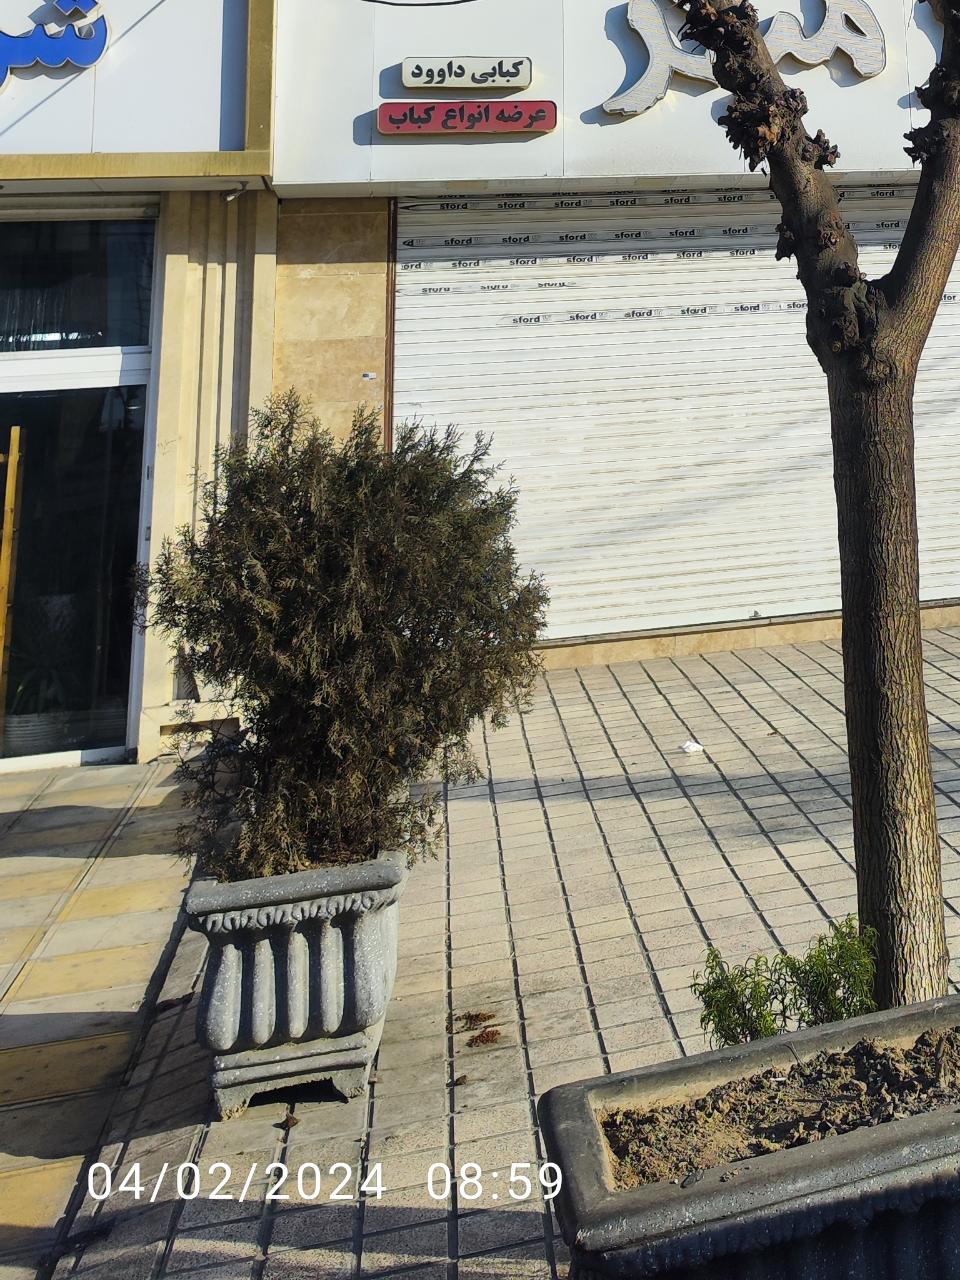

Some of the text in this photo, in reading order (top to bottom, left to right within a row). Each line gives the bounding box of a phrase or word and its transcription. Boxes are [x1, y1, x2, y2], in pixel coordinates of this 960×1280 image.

[411, 60, 524, 85] کبابی داوود
[388, 104, 547, 130] عرضه انواع کباب
